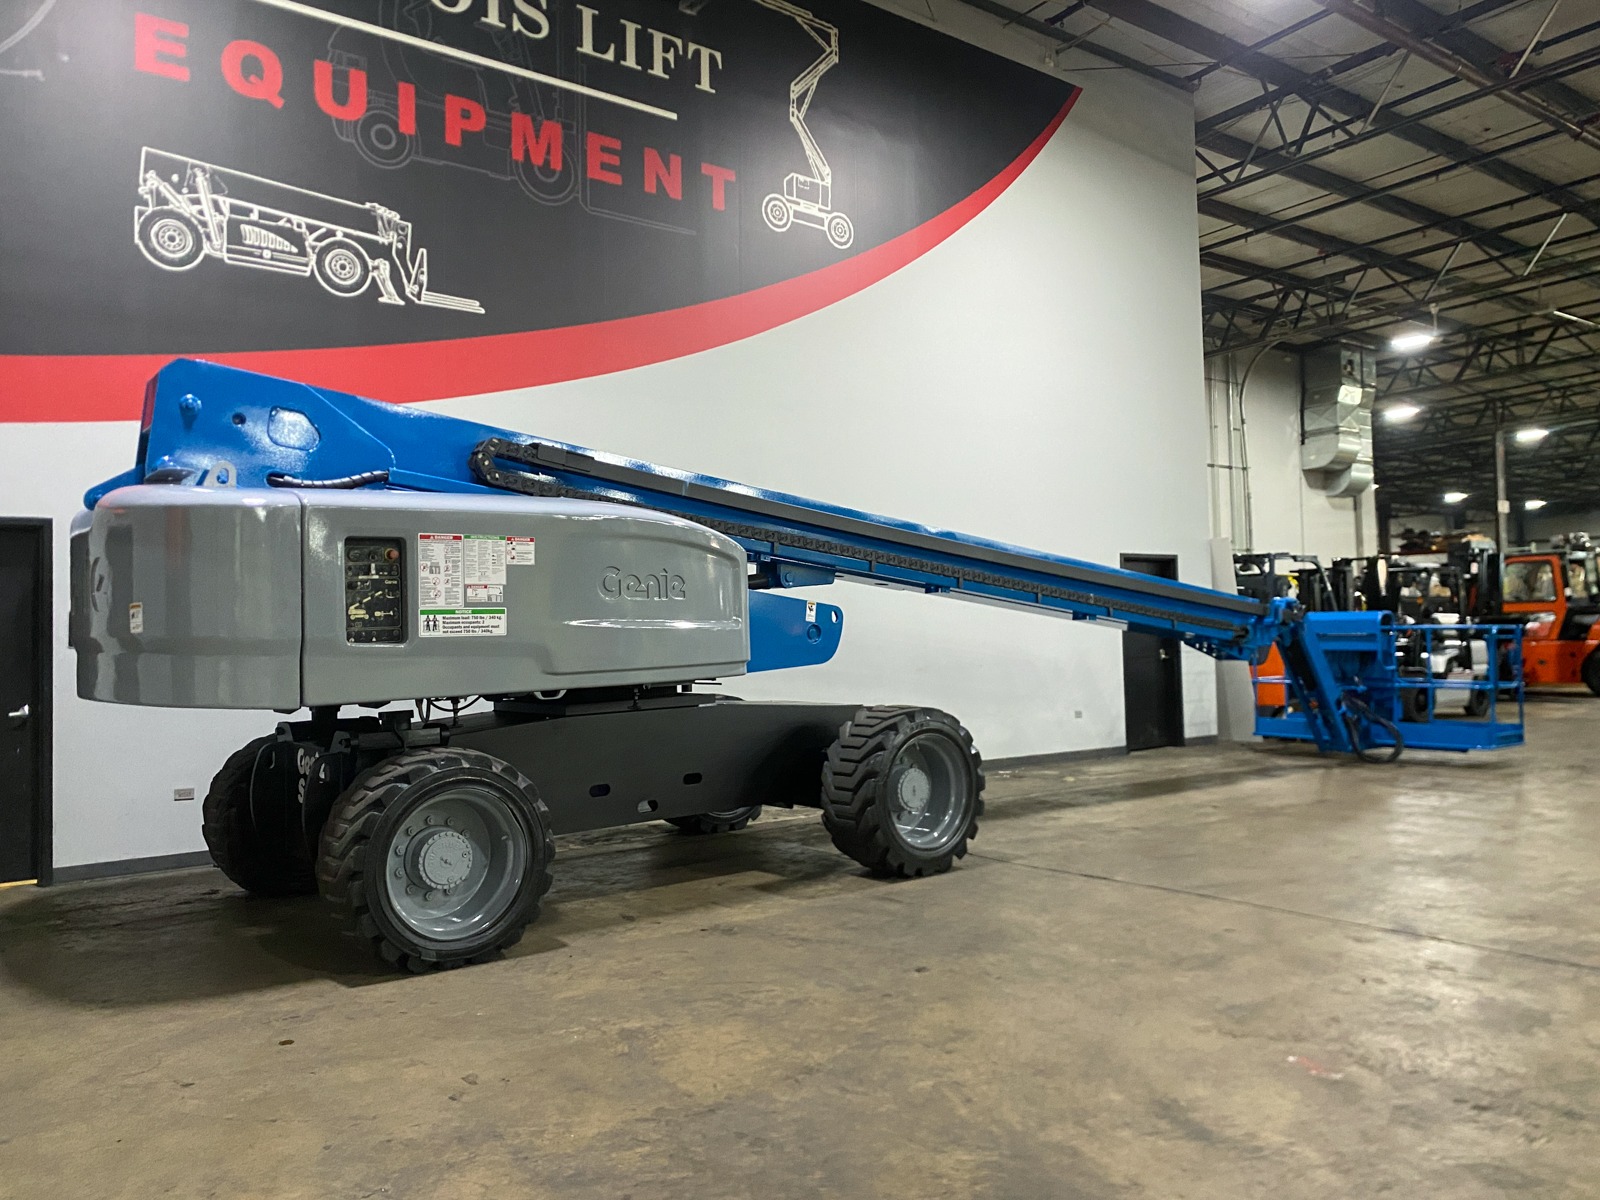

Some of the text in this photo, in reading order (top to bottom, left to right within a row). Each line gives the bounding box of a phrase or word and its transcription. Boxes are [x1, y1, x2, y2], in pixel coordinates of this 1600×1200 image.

[577, 4, 722, 94] LIFT
[134, 13, 737, 212] EQUIPMENT
[597, 566, 686, 601] Genie
